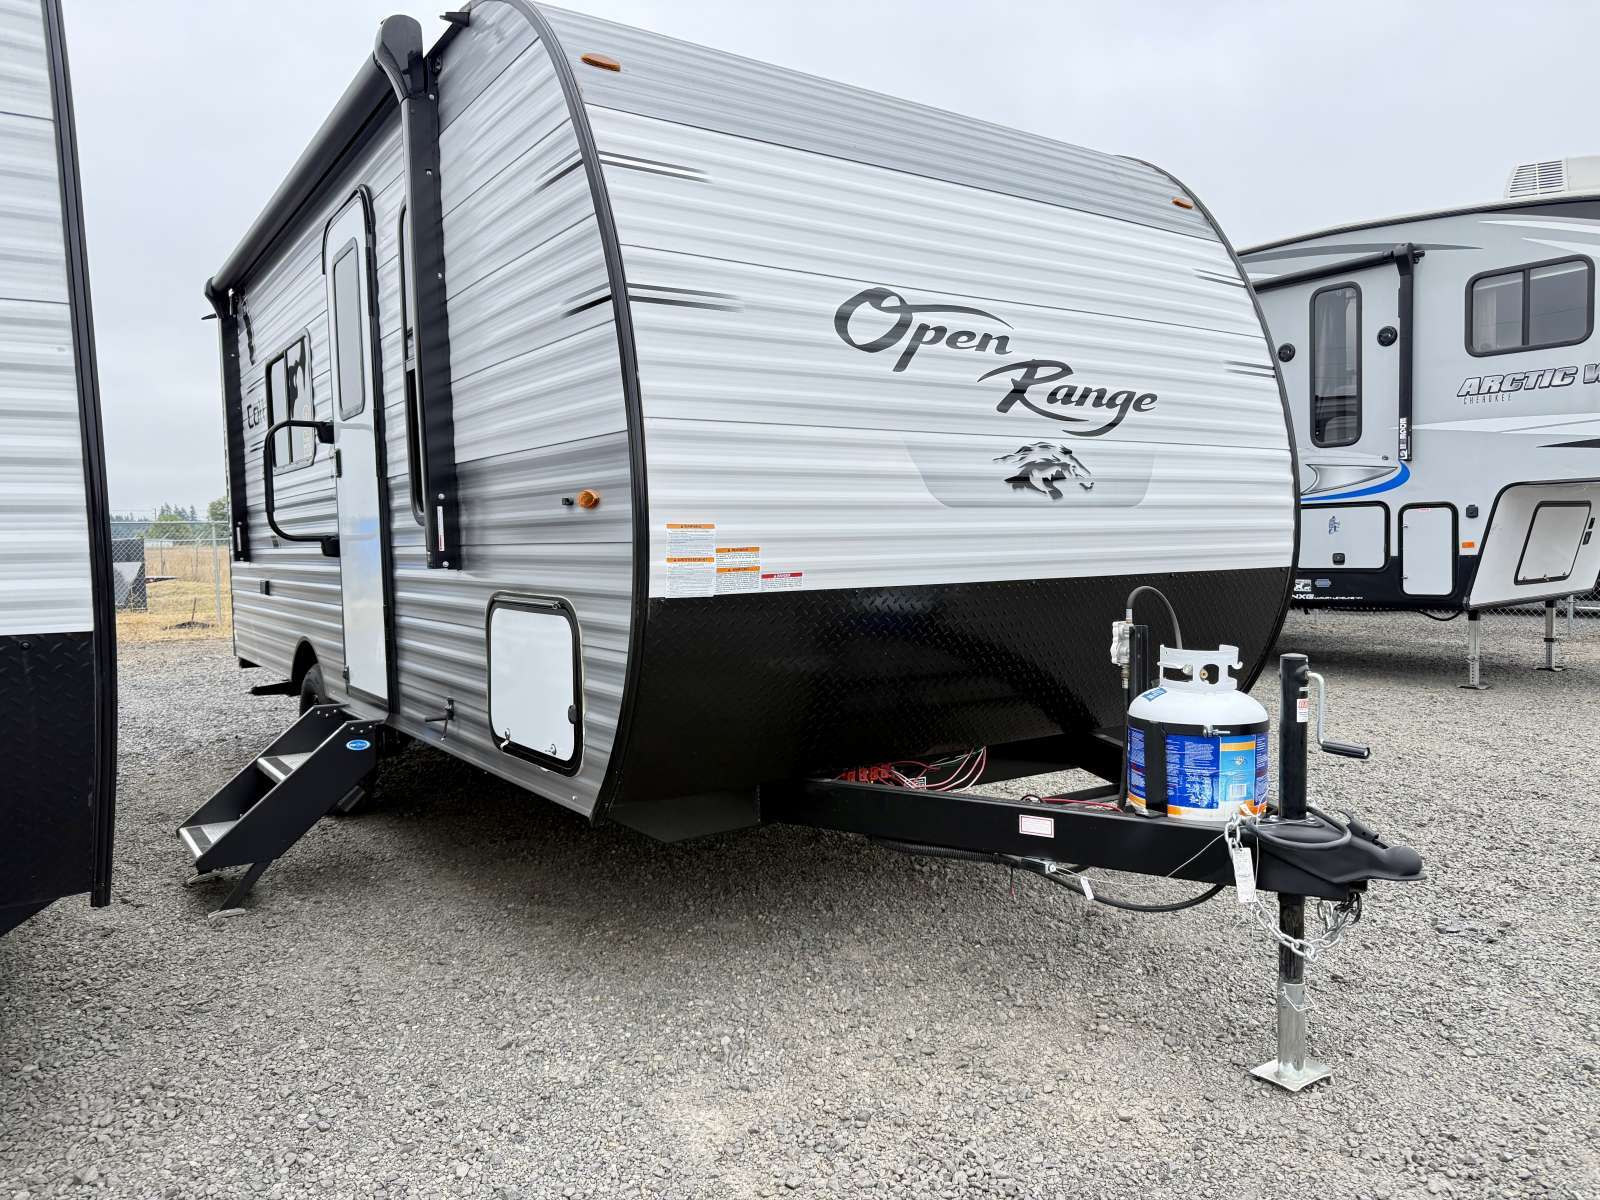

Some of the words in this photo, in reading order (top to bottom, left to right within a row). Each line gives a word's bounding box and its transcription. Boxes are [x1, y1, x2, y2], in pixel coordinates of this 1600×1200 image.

[834, 287, 1014, 372] Open
[977, 359, 1158, 437] Range
[1457, 366, 1578, 397] ARCTIC
